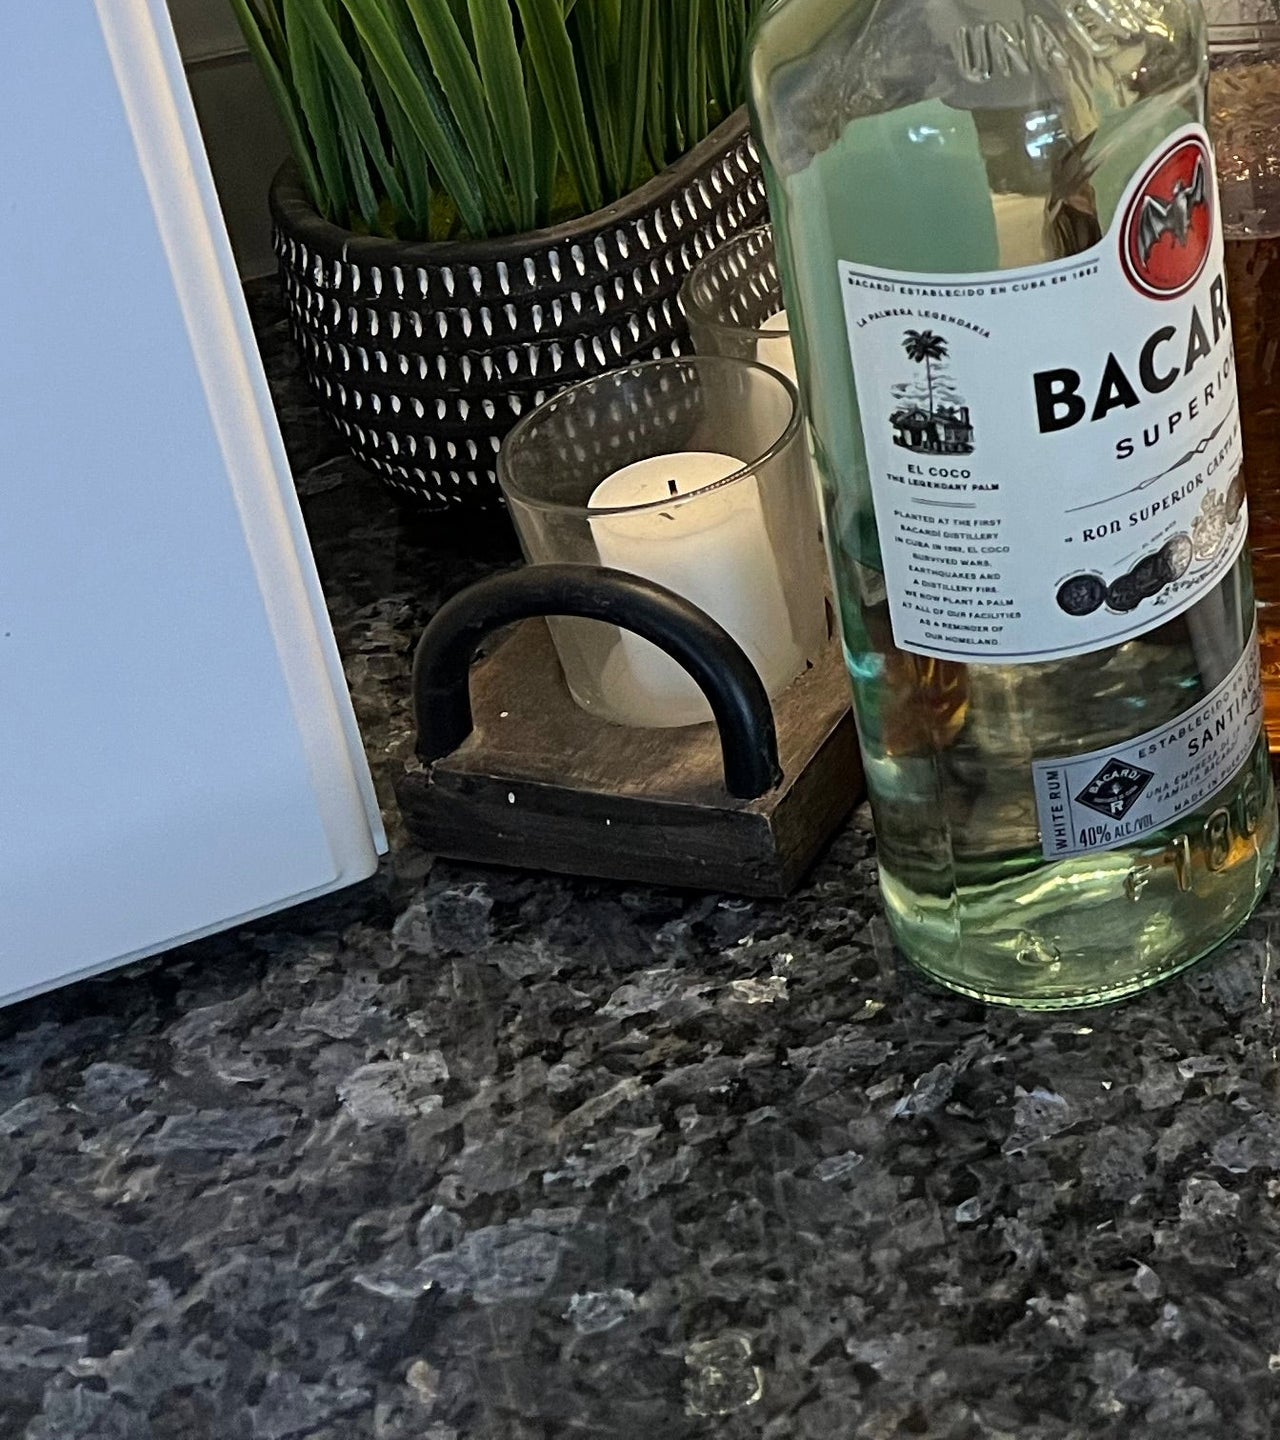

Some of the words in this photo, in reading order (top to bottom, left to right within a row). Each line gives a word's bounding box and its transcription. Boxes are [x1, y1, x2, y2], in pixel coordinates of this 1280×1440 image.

[899, 285, 985, 298] ESTABLECIDO
[990, 286, 1008, 296] EN
[1012, 279, 1047, 293] CUBA
[1051, 274, 1068, 286] EN
[856, 316, 868, 328] LA
[917, 308, 991, 339] LEGENDARIA
[1033, 273, 1227, 435] BACAR
[886, 473, 905, 484] THE
[908, 478, 968, 491] LEGENDARY
[907, 464, 924, 475] EL
[928, 467, 971, 479] COCO
[1128, 473, 1204, 527] SUPERIOR
[893, 510, 936, 525] PLANTED
[937, 517, 950, 526] AT
[953, 519, 972, 527] THE
[981, 546, 1010, 554] COCO
[908, 564, 977, 580] EARTHQUAKES
[969, 611, 1021, 619] FACILITIES
[925, 631, 943, 641] OUR
[1187, 664, 1256, 757] SANTIAG
[1138, 691, 1230, 759] ESTABLECIDO
[1046, 770, 1064, 800] RUM
[1146, 782, 1169, 799] UNA
[1173, 789, 1204, 812] MADE
[1050, 804, 1068, 851] WHITE
[1079, 823, 1112, 848] 40%
